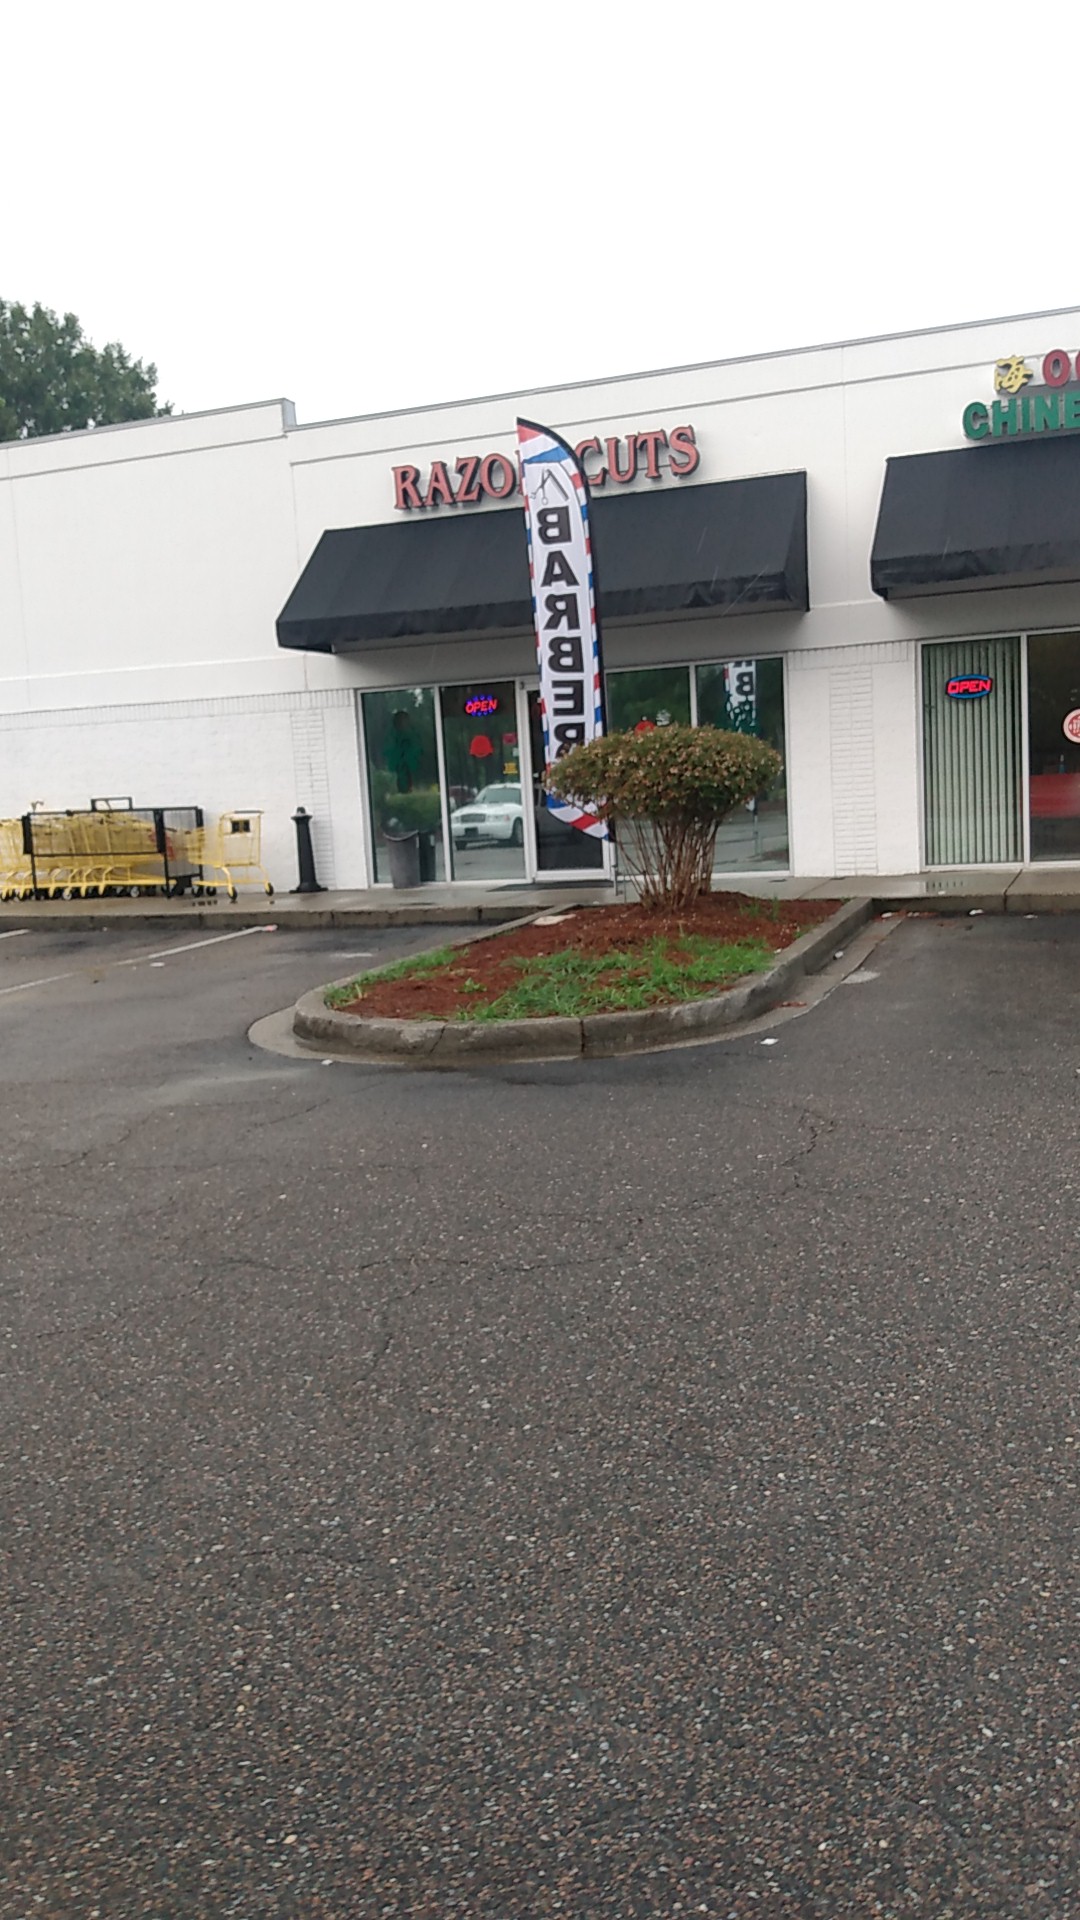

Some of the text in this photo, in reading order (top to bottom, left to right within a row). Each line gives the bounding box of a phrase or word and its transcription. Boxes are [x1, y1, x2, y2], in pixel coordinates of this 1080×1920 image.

[1042, 349, 1080, 388] O
[391, 425, 700, 509] RAZO CUTS
[947, 679, 992, 694] OPEN
[465, 699, 497, 714] OPEN
